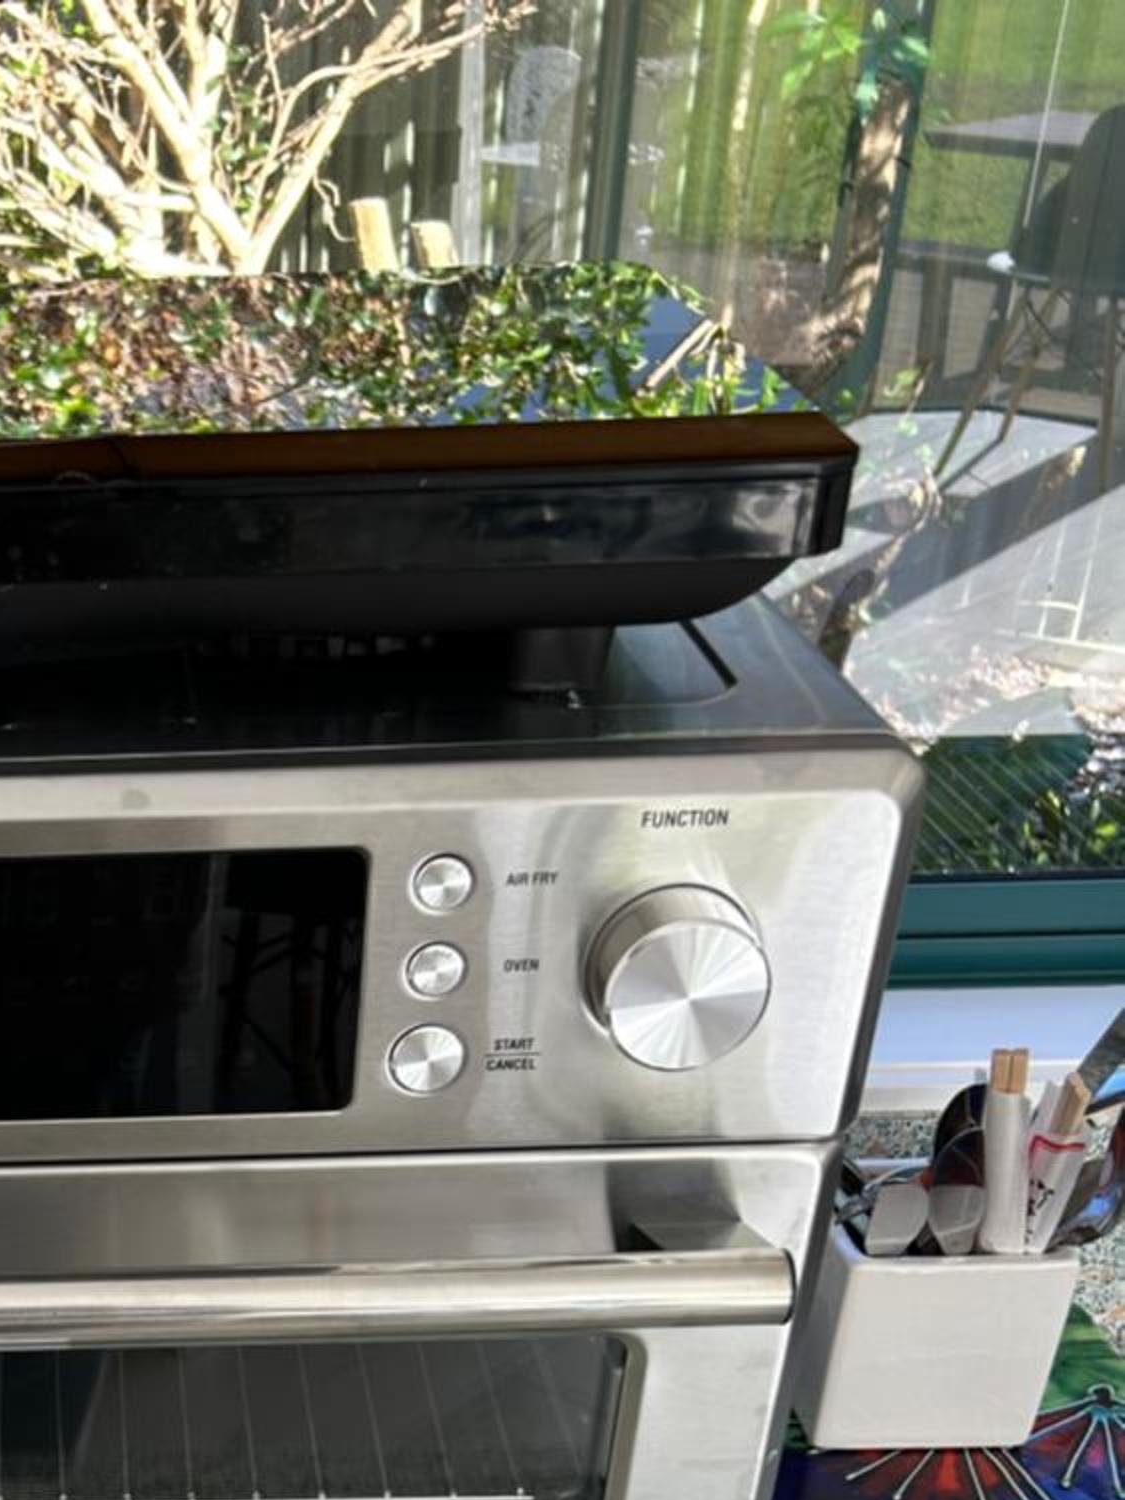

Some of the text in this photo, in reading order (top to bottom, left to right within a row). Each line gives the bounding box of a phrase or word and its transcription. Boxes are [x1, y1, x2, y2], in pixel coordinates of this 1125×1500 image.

[641, 809, 729, 828] FUNCTION
[506, 871, 559, 886] AIR FRY
[503, 958, 540, 973] OVEN
[494, 1037, 535, 1051] START
[486, 1057, 537, 1072] CANCEL
